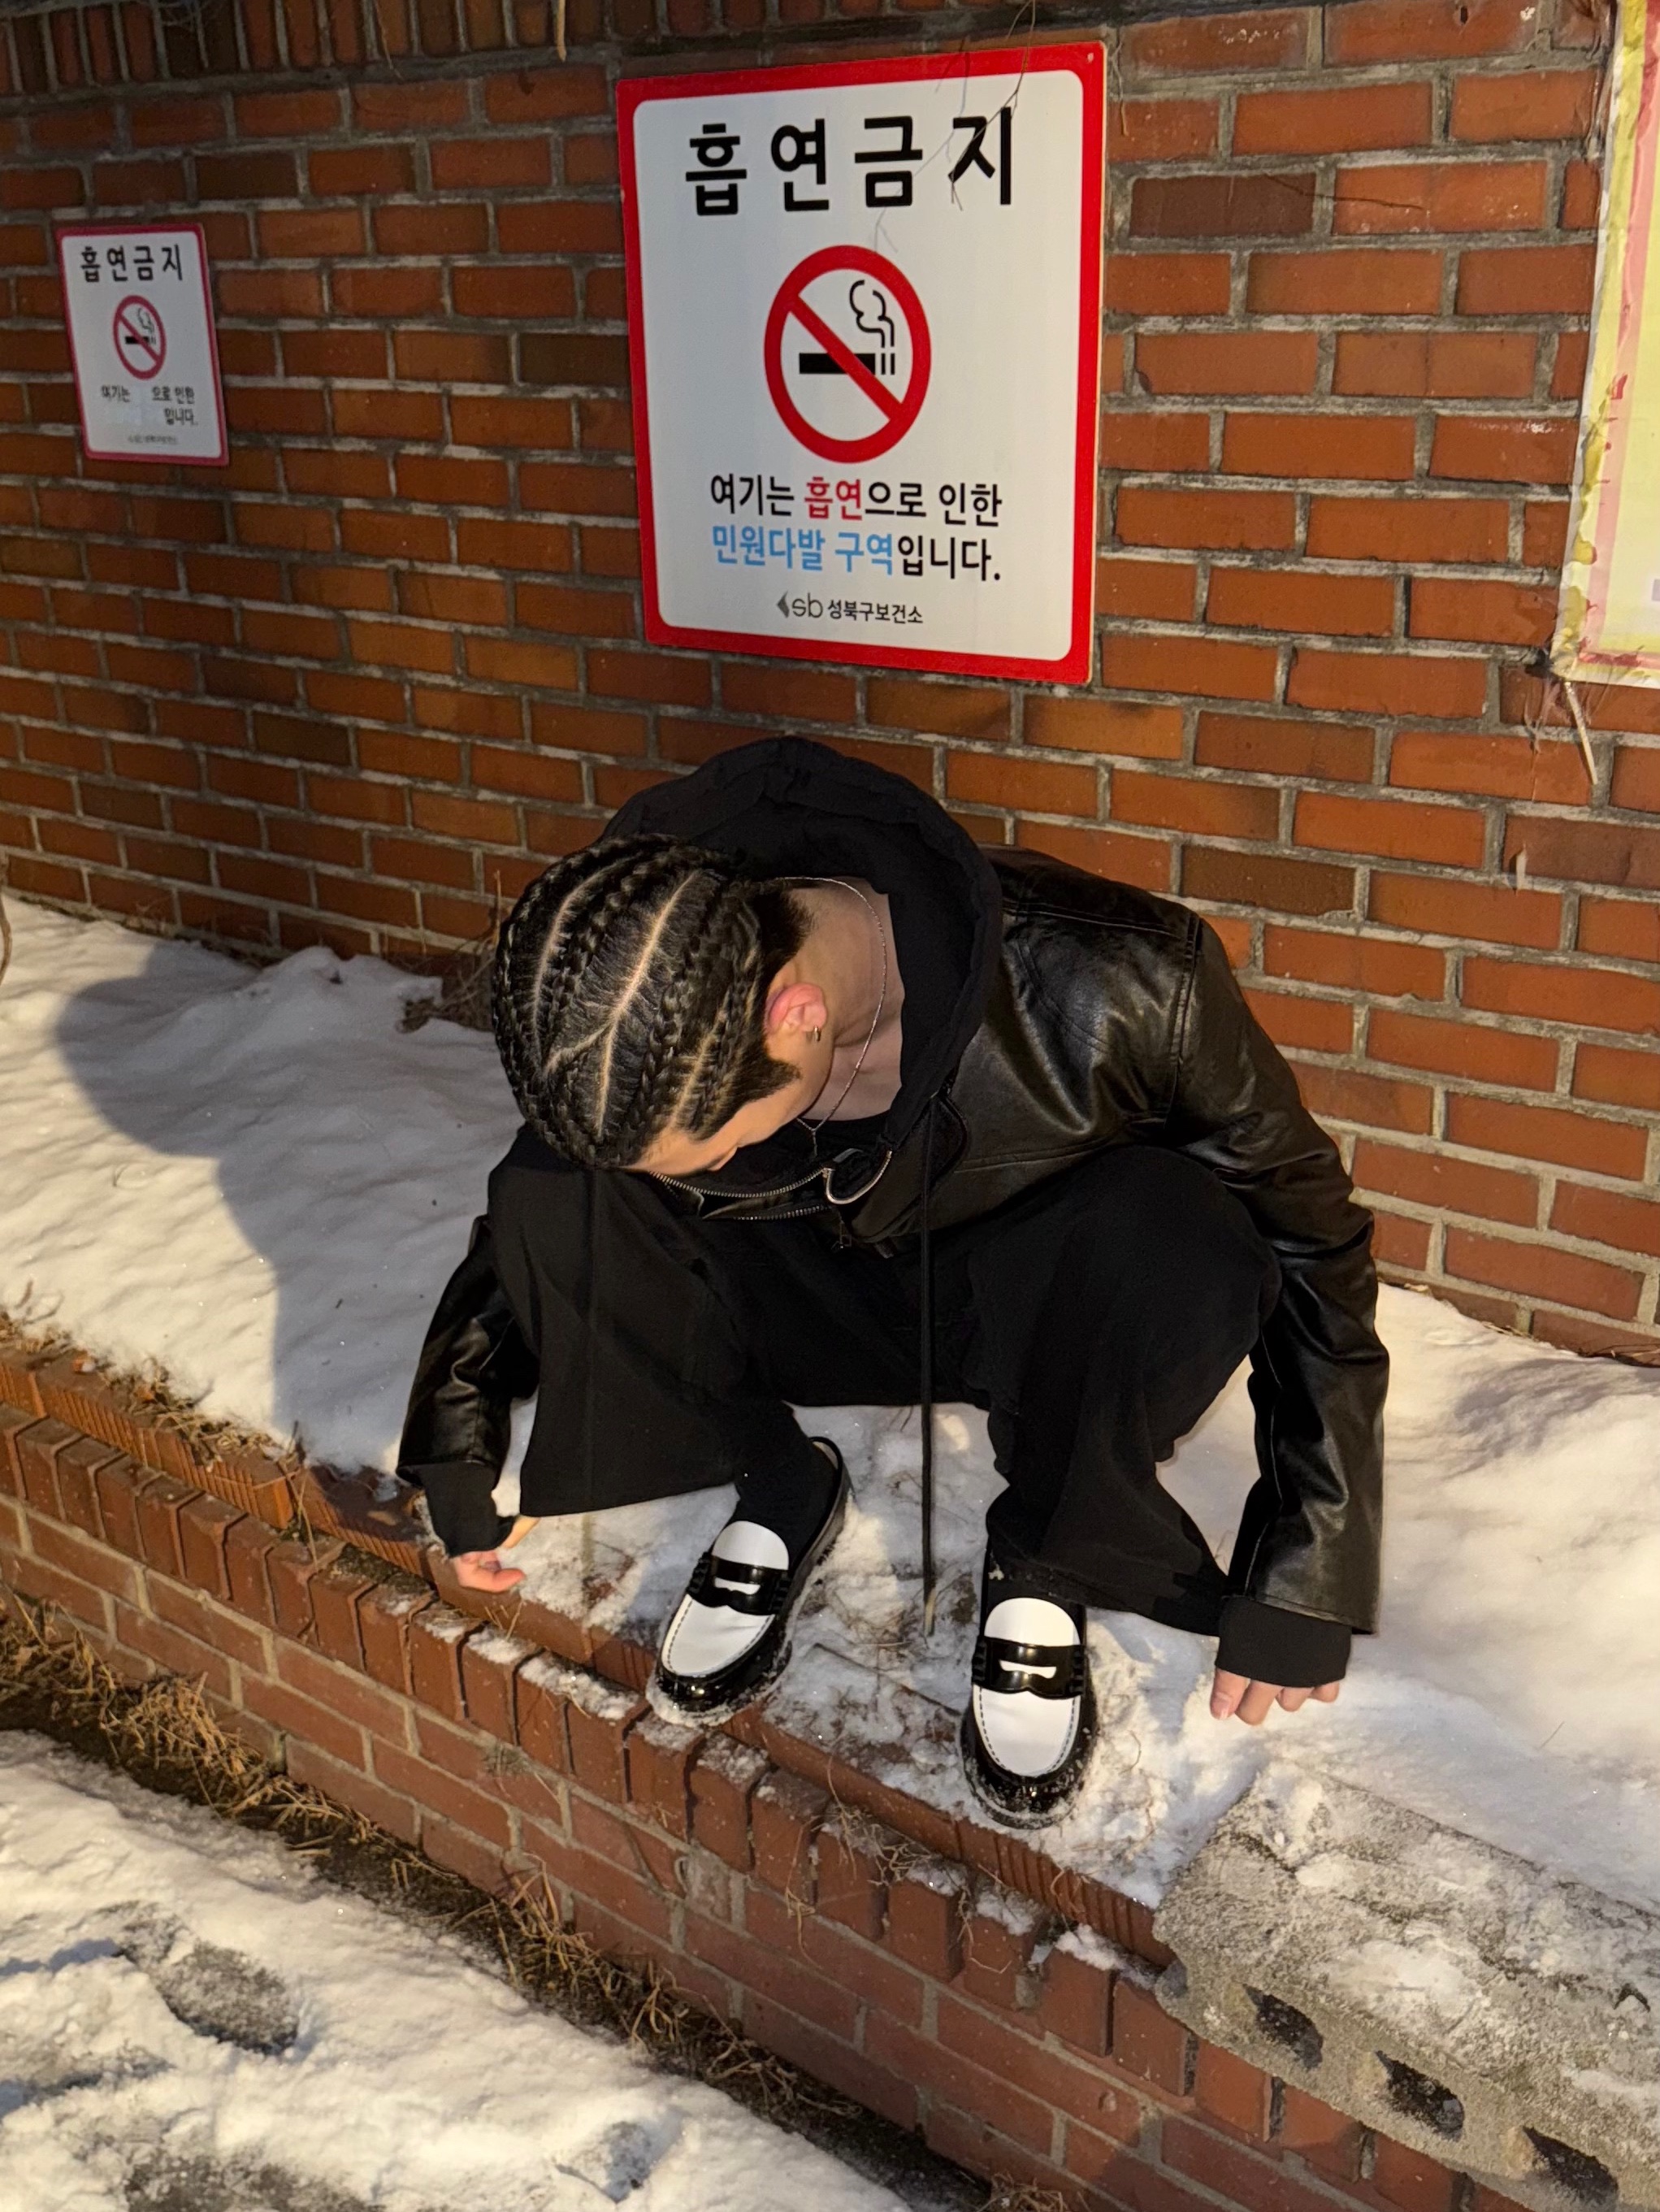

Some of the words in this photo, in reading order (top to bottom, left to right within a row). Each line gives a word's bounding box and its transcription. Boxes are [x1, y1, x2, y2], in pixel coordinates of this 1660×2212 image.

[686, 107, 1011, 215] 흡연금지
[80, 244, 182, 283] 흡연금지
[711, 473, 795, 516] 여기는
[804, 476, 926, 520] 흡연으로
[938, 483, 1002, 527] 인한
[712, 524, 826, 571] 민원다발
[834, 531, 1001, 581] 구역입니다.
[827, 599, 924, 624] 성북구보건소
